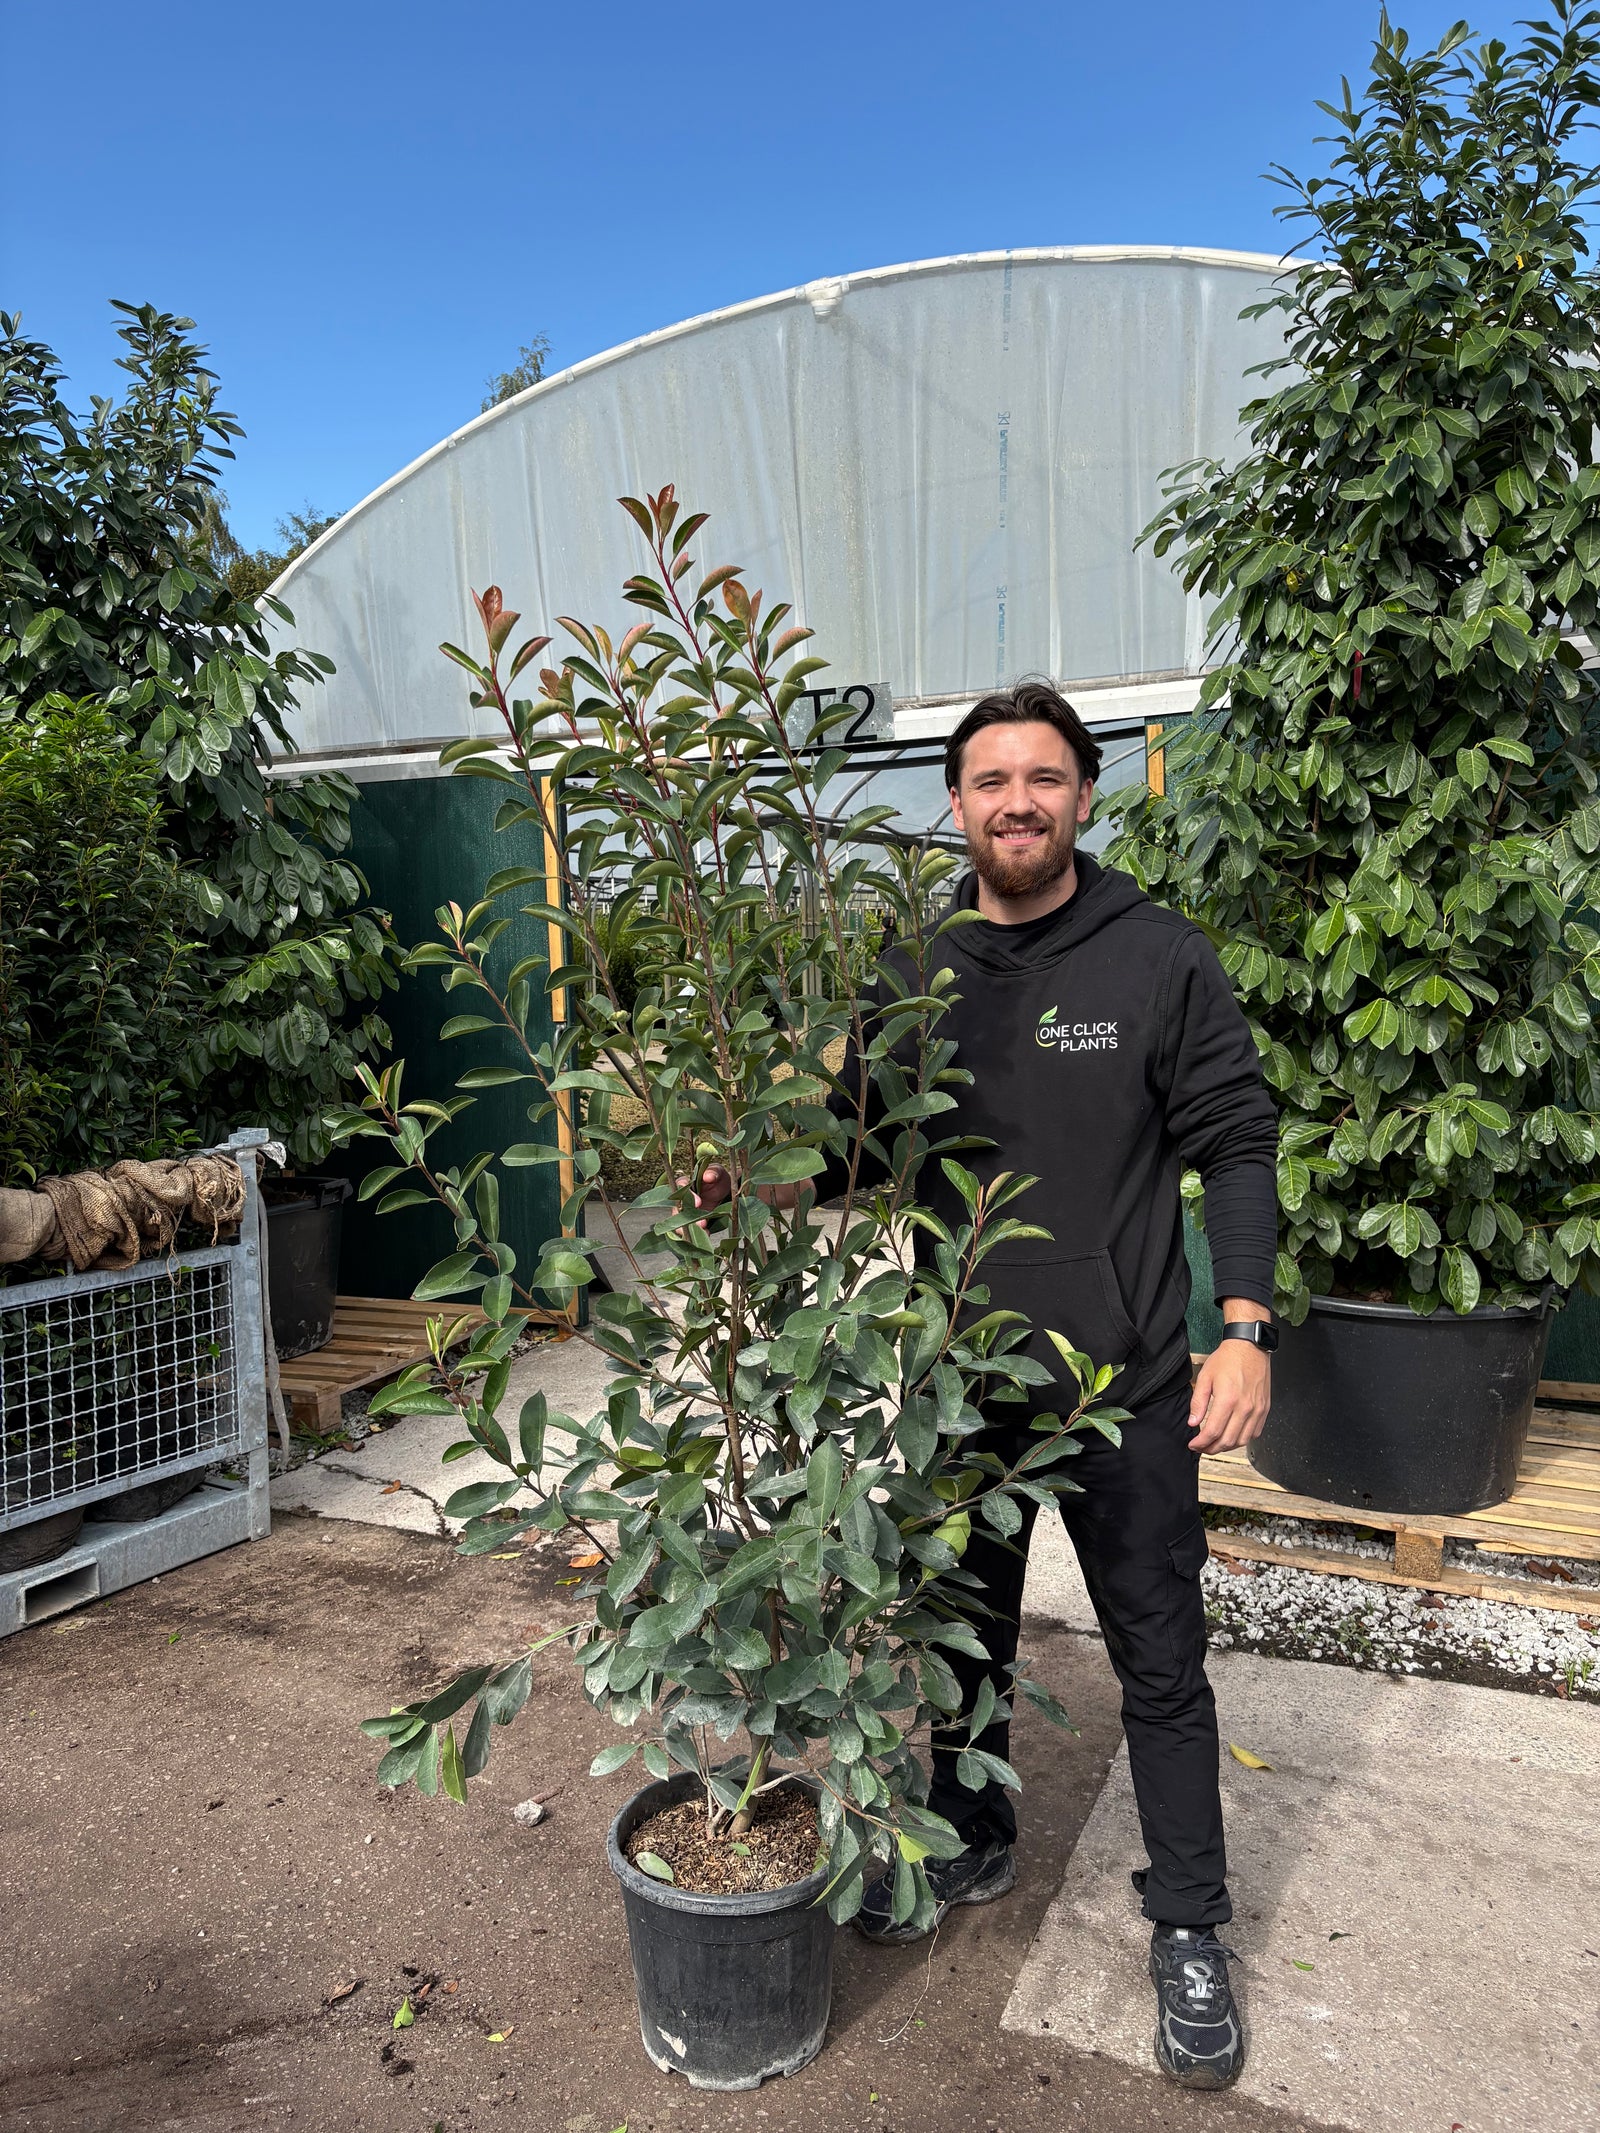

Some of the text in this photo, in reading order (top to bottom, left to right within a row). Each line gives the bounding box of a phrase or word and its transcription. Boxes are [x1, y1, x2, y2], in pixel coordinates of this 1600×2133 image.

[798, 685, 877, 746] T2
[1040, 1022, 1118, 1039] ONE CLICK
[1060, 1037, 1118, 1052] PLANTS
